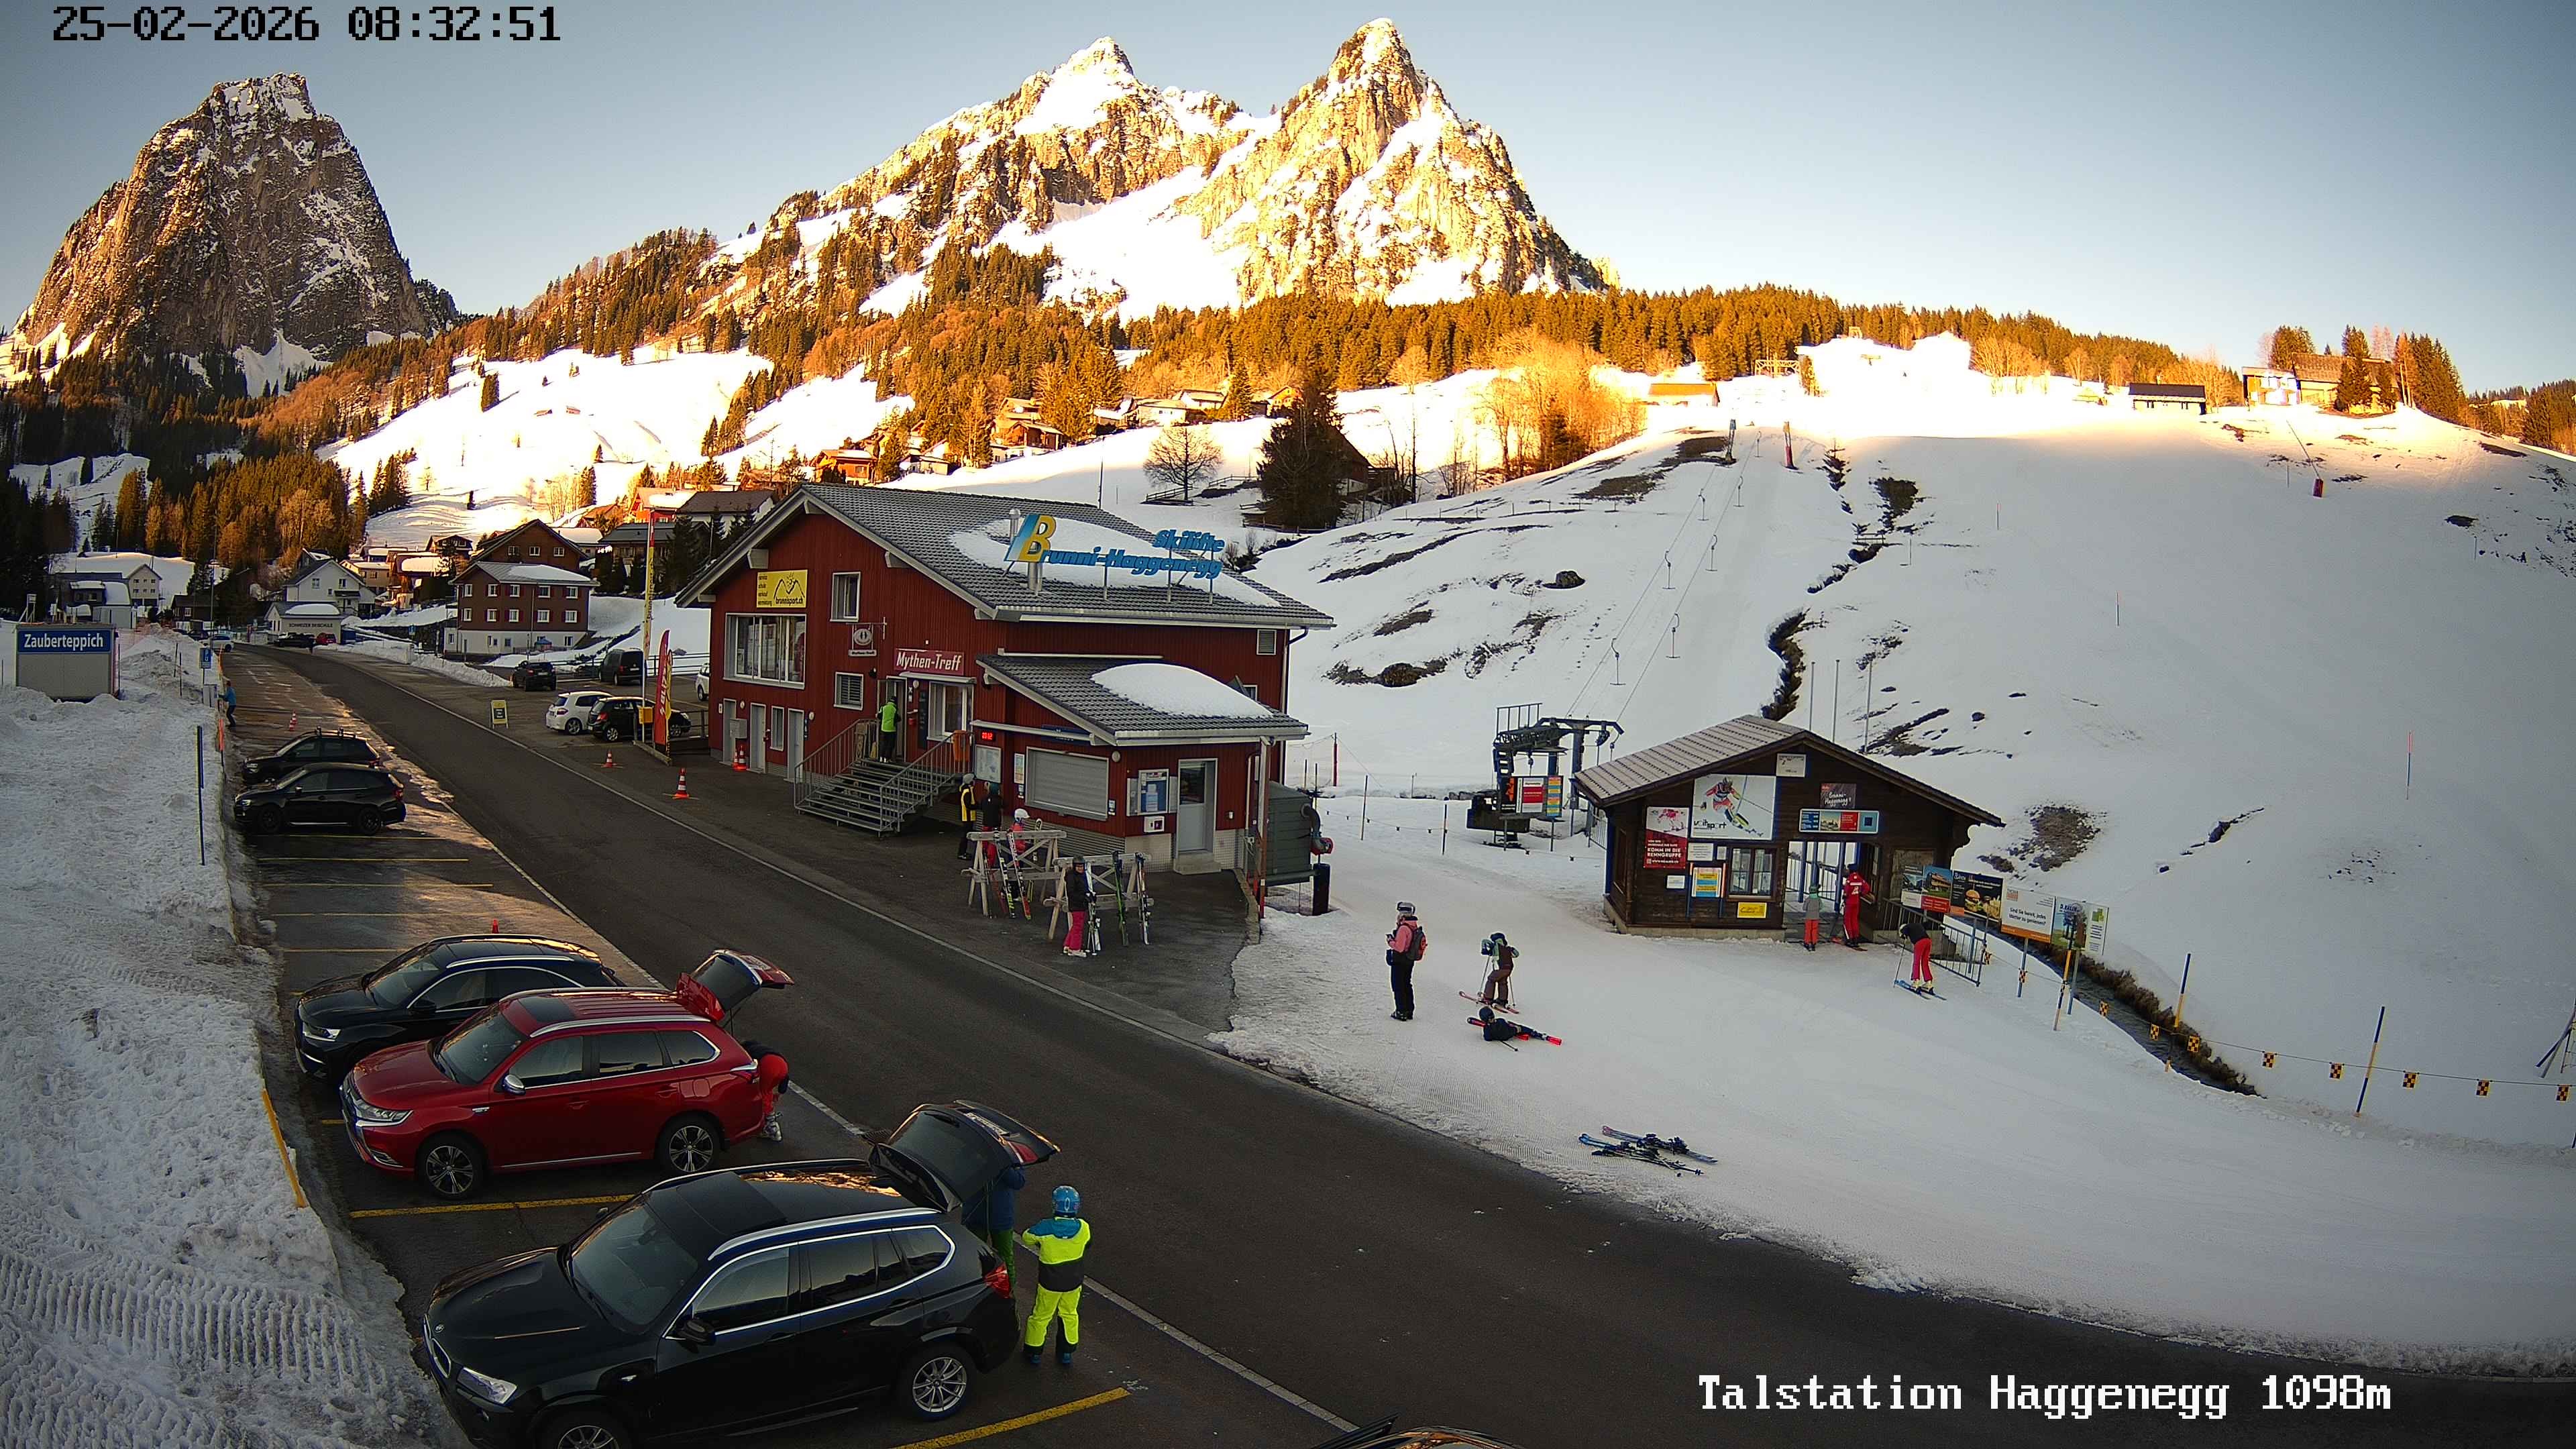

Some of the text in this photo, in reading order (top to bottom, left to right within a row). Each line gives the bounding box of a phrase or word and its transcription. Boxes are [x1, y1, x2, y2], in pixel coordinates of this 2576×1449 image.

[1004, 515, 1223, 579] Brunni-Haggenegg
[1152, 529, 1225, 552] Skilifte
[775, 596, 804, 606] brunnisport.ch
[23, 633, 104, 651] Zauberteppich
[896, 651, 962, 671] Mythen-Treff
